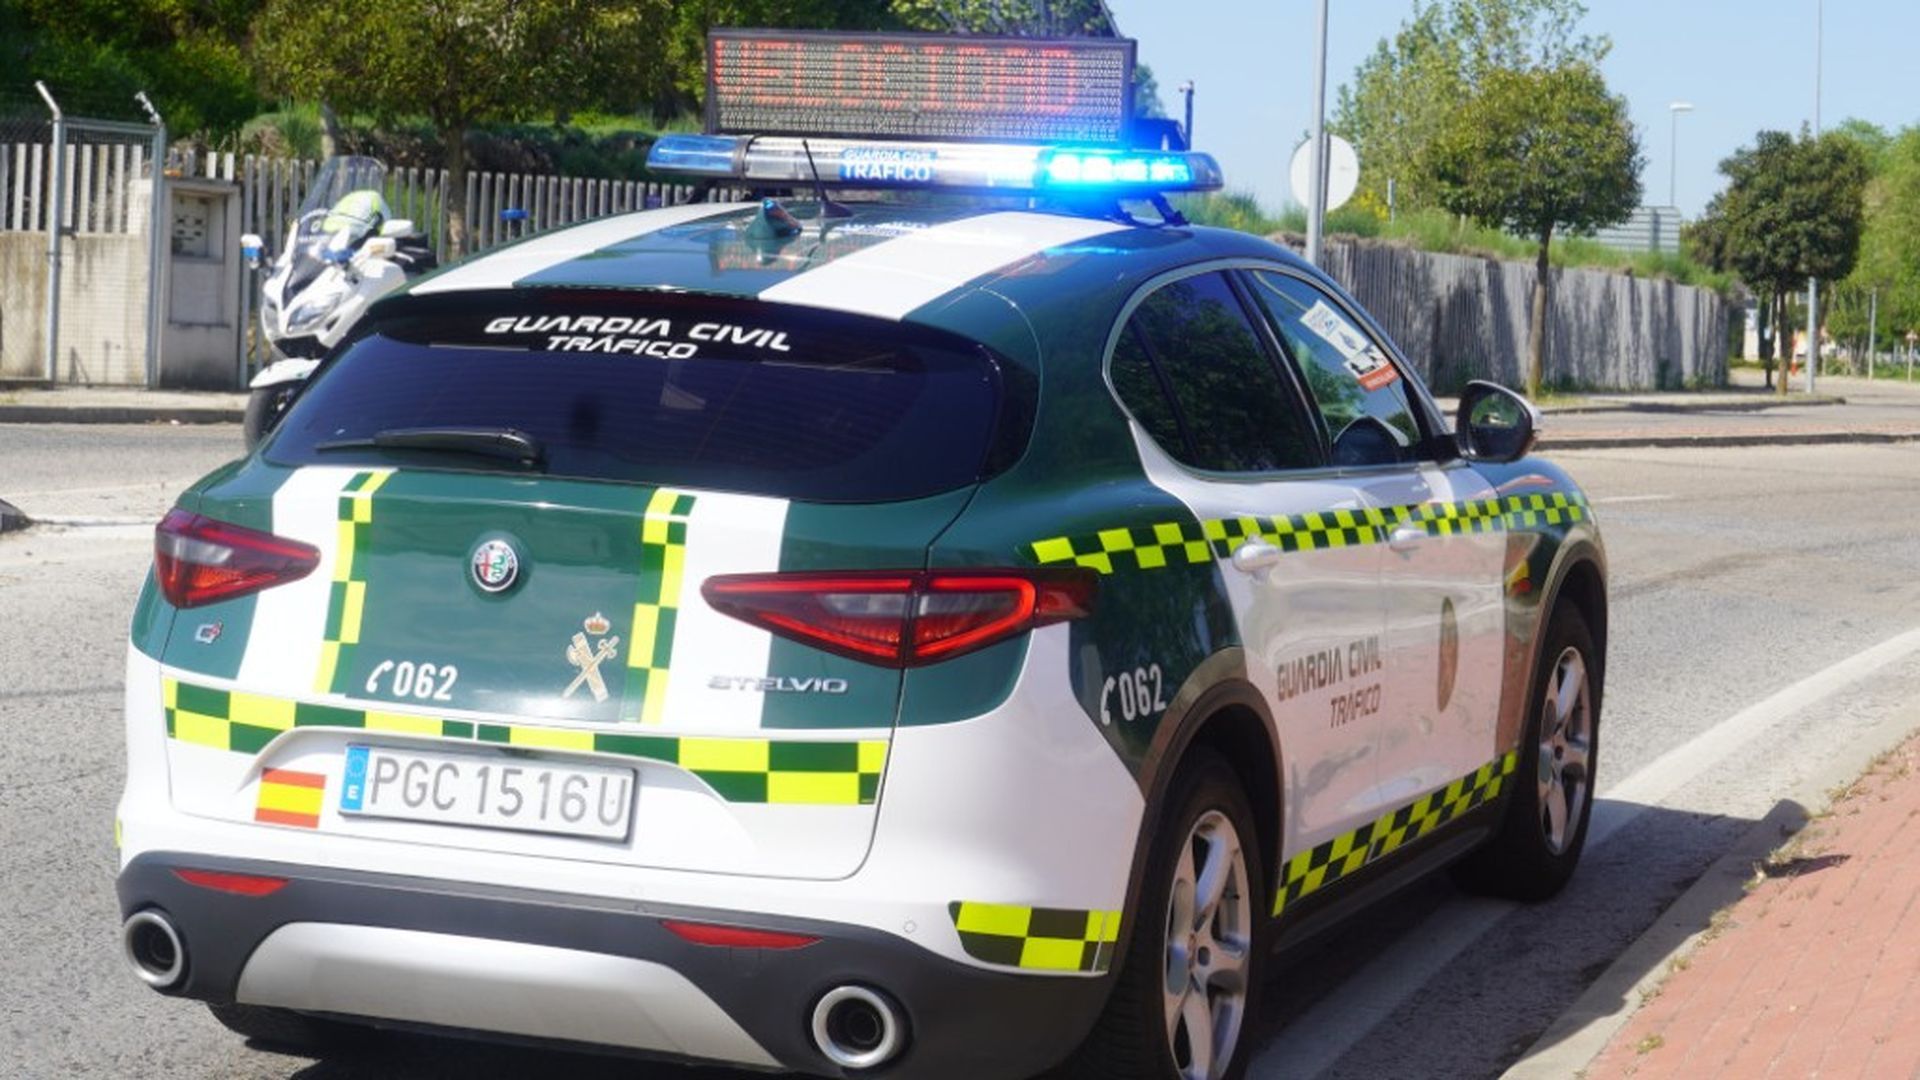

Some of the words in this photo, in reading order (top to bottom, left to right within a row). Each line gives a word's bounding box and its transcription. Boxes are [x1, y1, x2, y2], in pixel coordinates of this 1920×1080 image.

[484, 315, 671, 336] GUARDIA
[687, 323, 791, 351] CIVIL
[393, 661, 458, 700] 062
[707, 675, 849, 693] STELVIO
[1277, 645, 1343, 701] GUARDIA
[1119, 663, 1167, 721] 062
[347, 784, 360, 800] E
